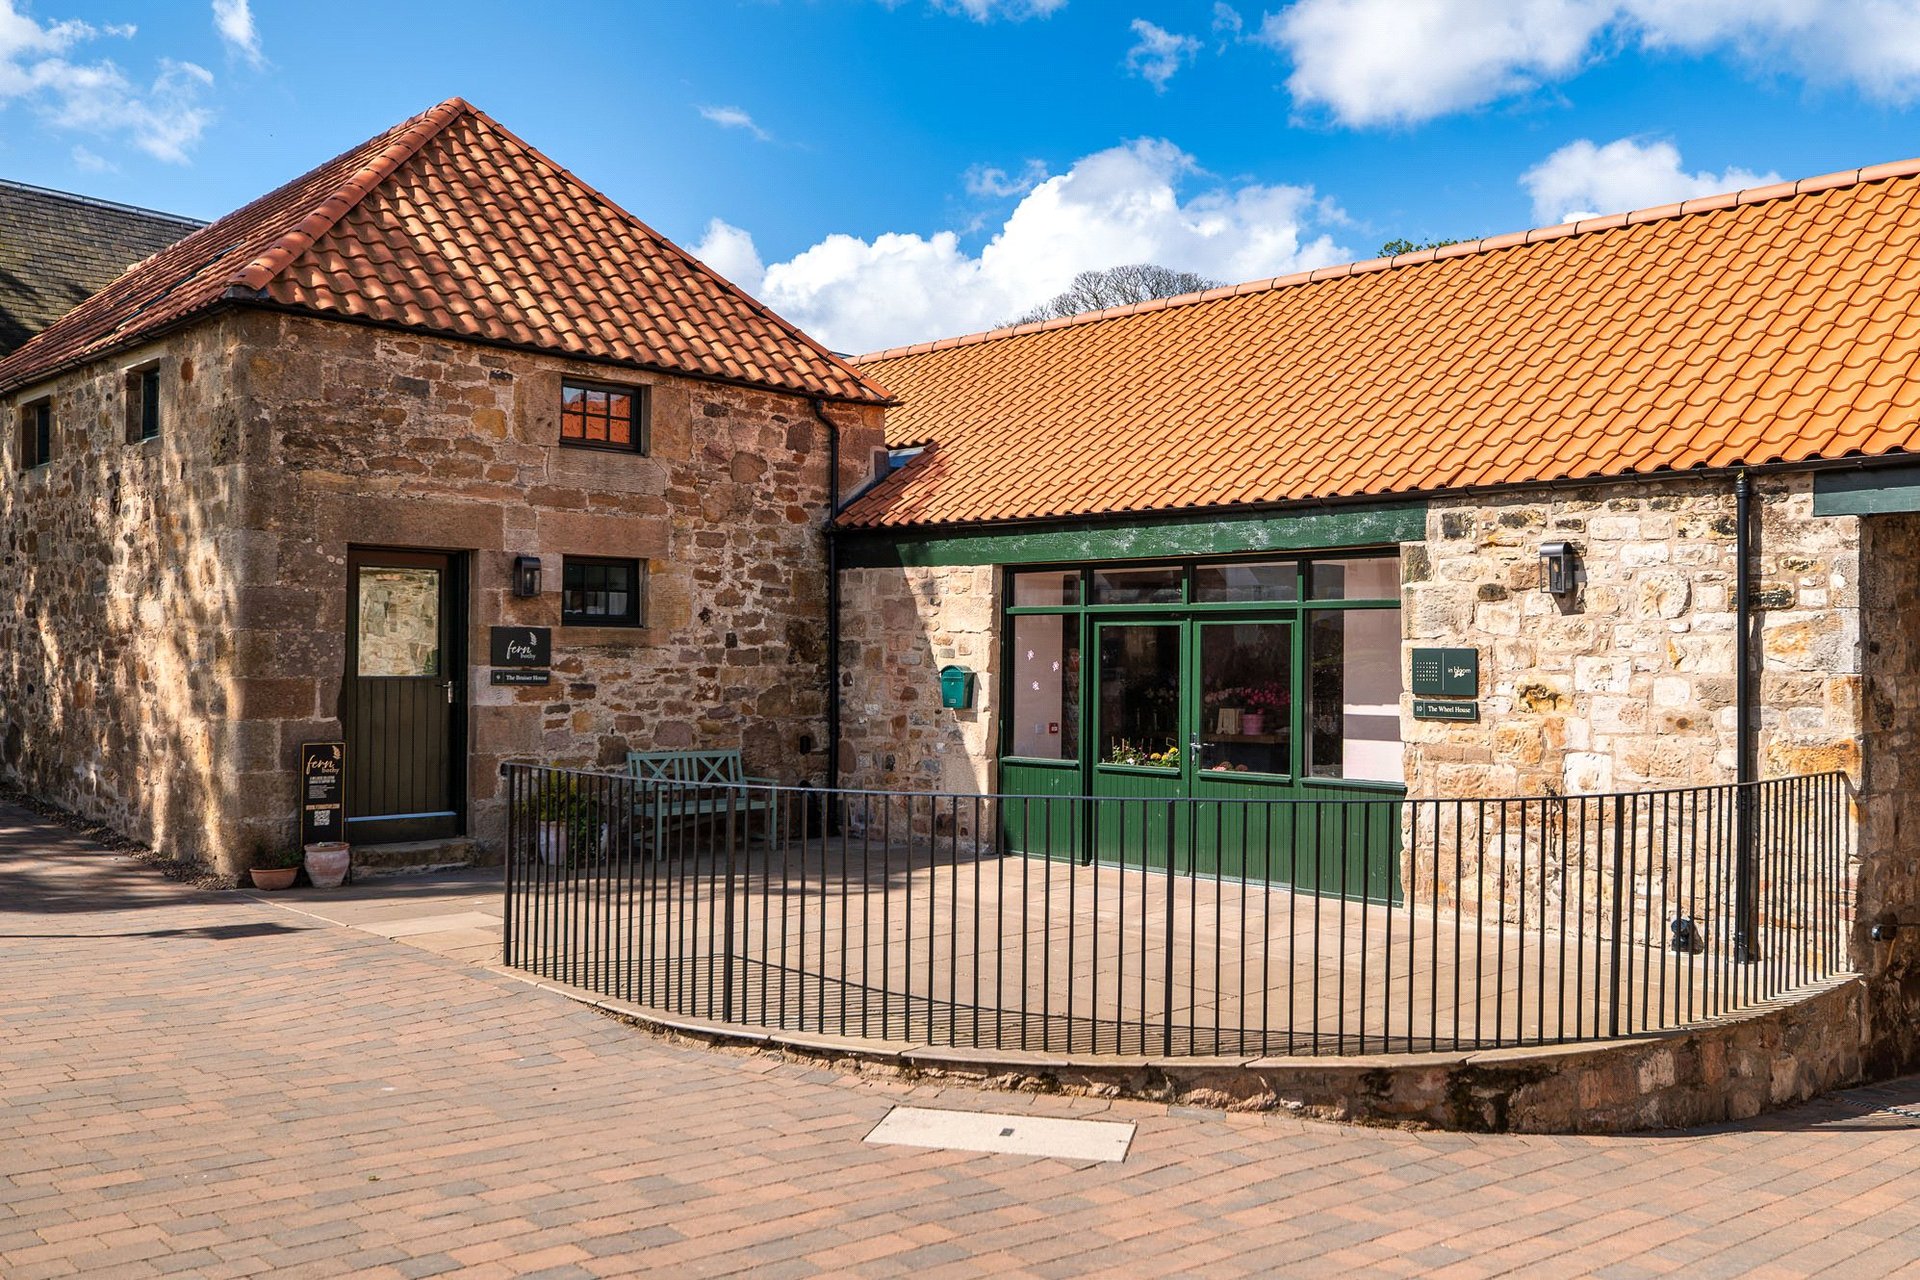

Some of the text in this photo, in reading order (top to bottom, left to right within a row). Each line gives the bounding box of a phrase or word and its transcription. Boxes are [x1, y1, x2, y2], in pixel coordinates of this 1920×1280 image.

[506, 640, 532, 660] fern
[1438, 705, 1454, 713] Wheel
[305, 754, 335, 775] fern
